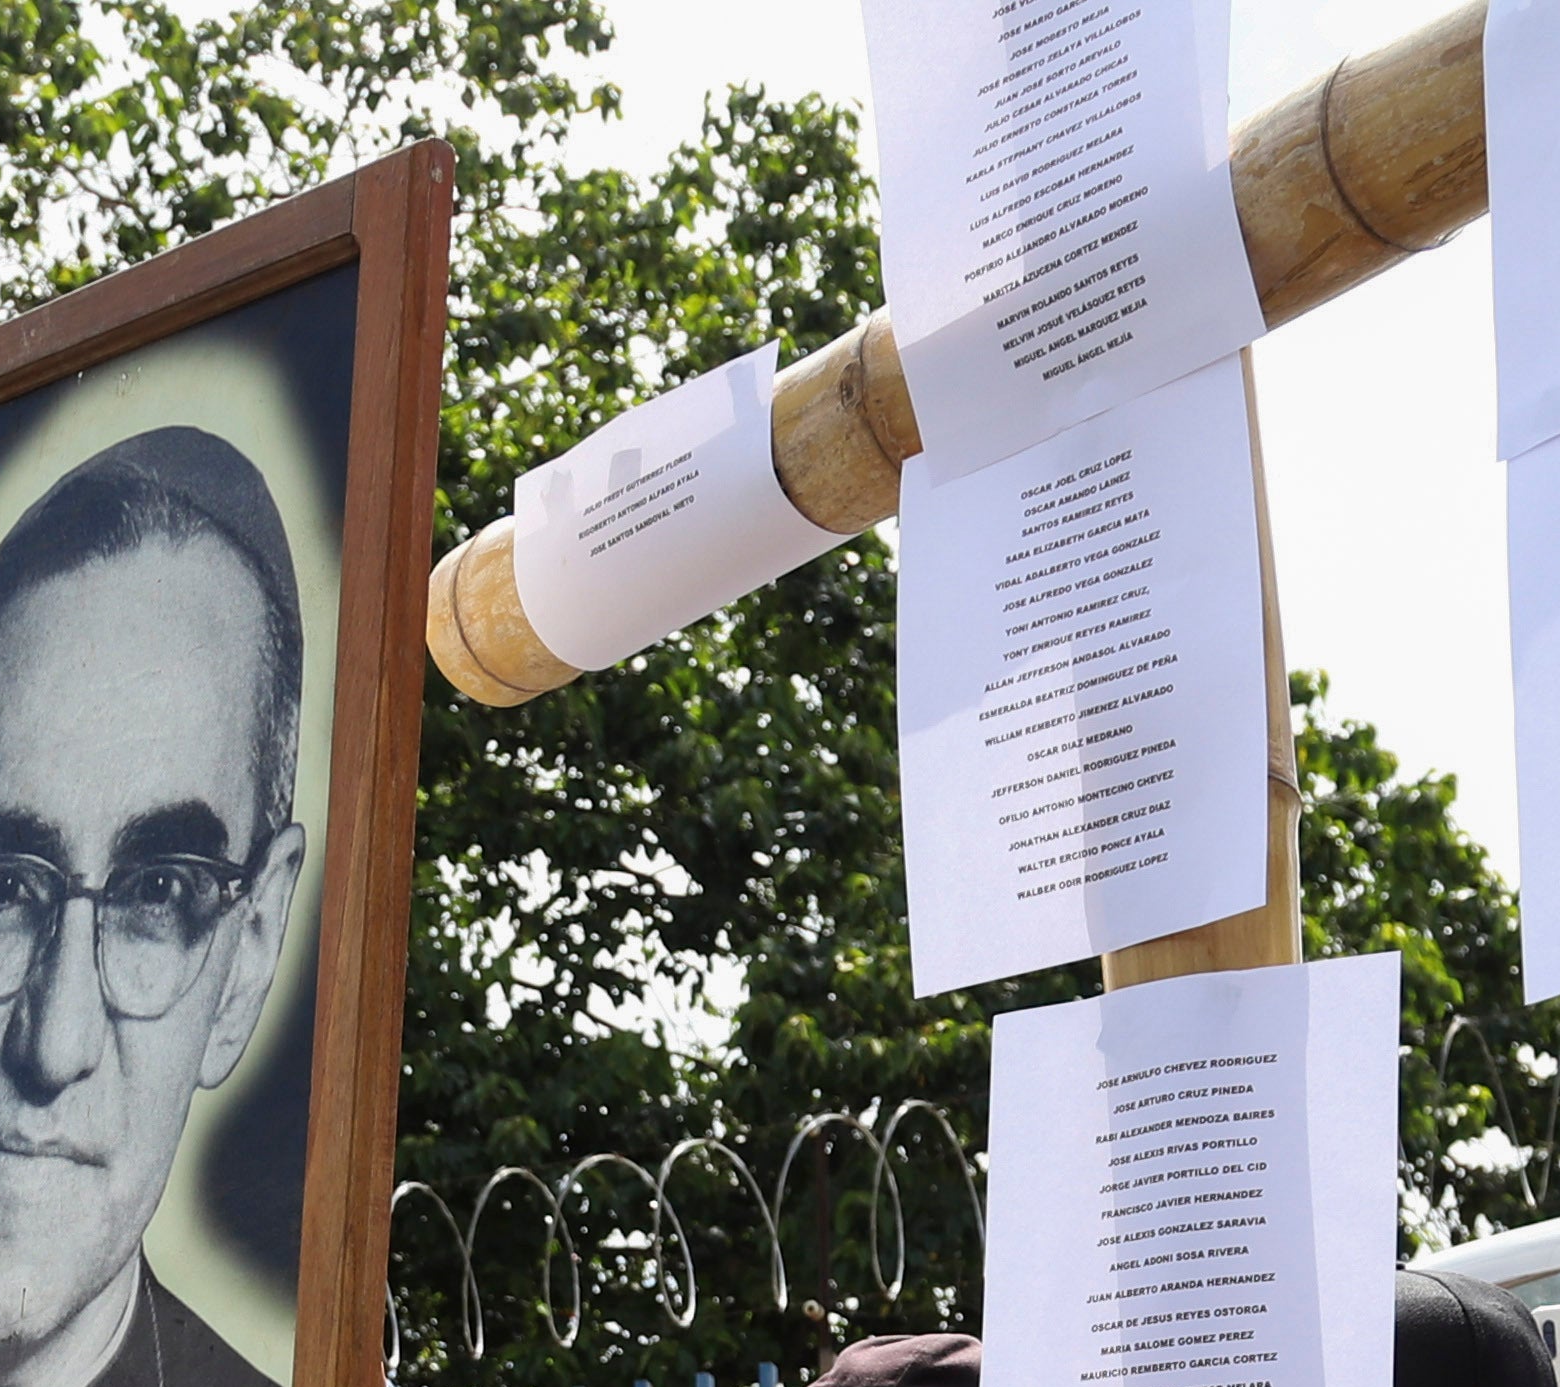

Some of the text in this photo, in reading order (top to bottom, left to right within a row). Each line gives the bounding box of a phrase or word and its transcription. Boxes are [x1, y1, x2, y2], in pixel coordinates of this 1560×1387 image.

[970, 145, 1134, 231] LUIS ALFREDO ESCOBAR HERNANDEZ
[997, 253, 1139, 330] MARVIN ROLANDO SANTOS REYES
[1003, 275, 1146, 351] MELVIN JOSUÉ VELÁSQUEZ REYES
[1014, 298, 1148, 369] MIGUEL ANGEL MARQUEZ MEJIA
[1042, 332, 1133, 381] MIGUEL ÁNGEL MEJÍA
[1021, 449, 1132, 500] OSCAR JOEL CRUZ LOPEZ
[1024, 471, 1130, 517] OSCAR AMANDO LAINEZ
[590, 495, 694, 557] JOSE SANTOS SANDOVAL NIETO
[995, 530, 1160, 591] VIDAL ADALBERTO VEGA GONZALEZ
[1027, 724, 1133, 762] OSCAR DIAZ MEDRANO
[991, 739, 1176, 798] JEFFERSON DANIEL RODRIGUEZ PINEDA
[1018, 828, 1165, 874] WALTER ERCIDIO PONCE AYALA
[1113, 1085, 1254, 1115] JOSE ARTURO CRUZ PINEDA
[1101, 1189, 1263, 1219] FRANCISCO JAVIER HERNANDEZ
[1109, 1246, 1249, 1272] ANGEL ADONI SOSA RIVERA
[1101, 1330, 1254, 1355] MARIA SALOME GOMEZ PEREZ
